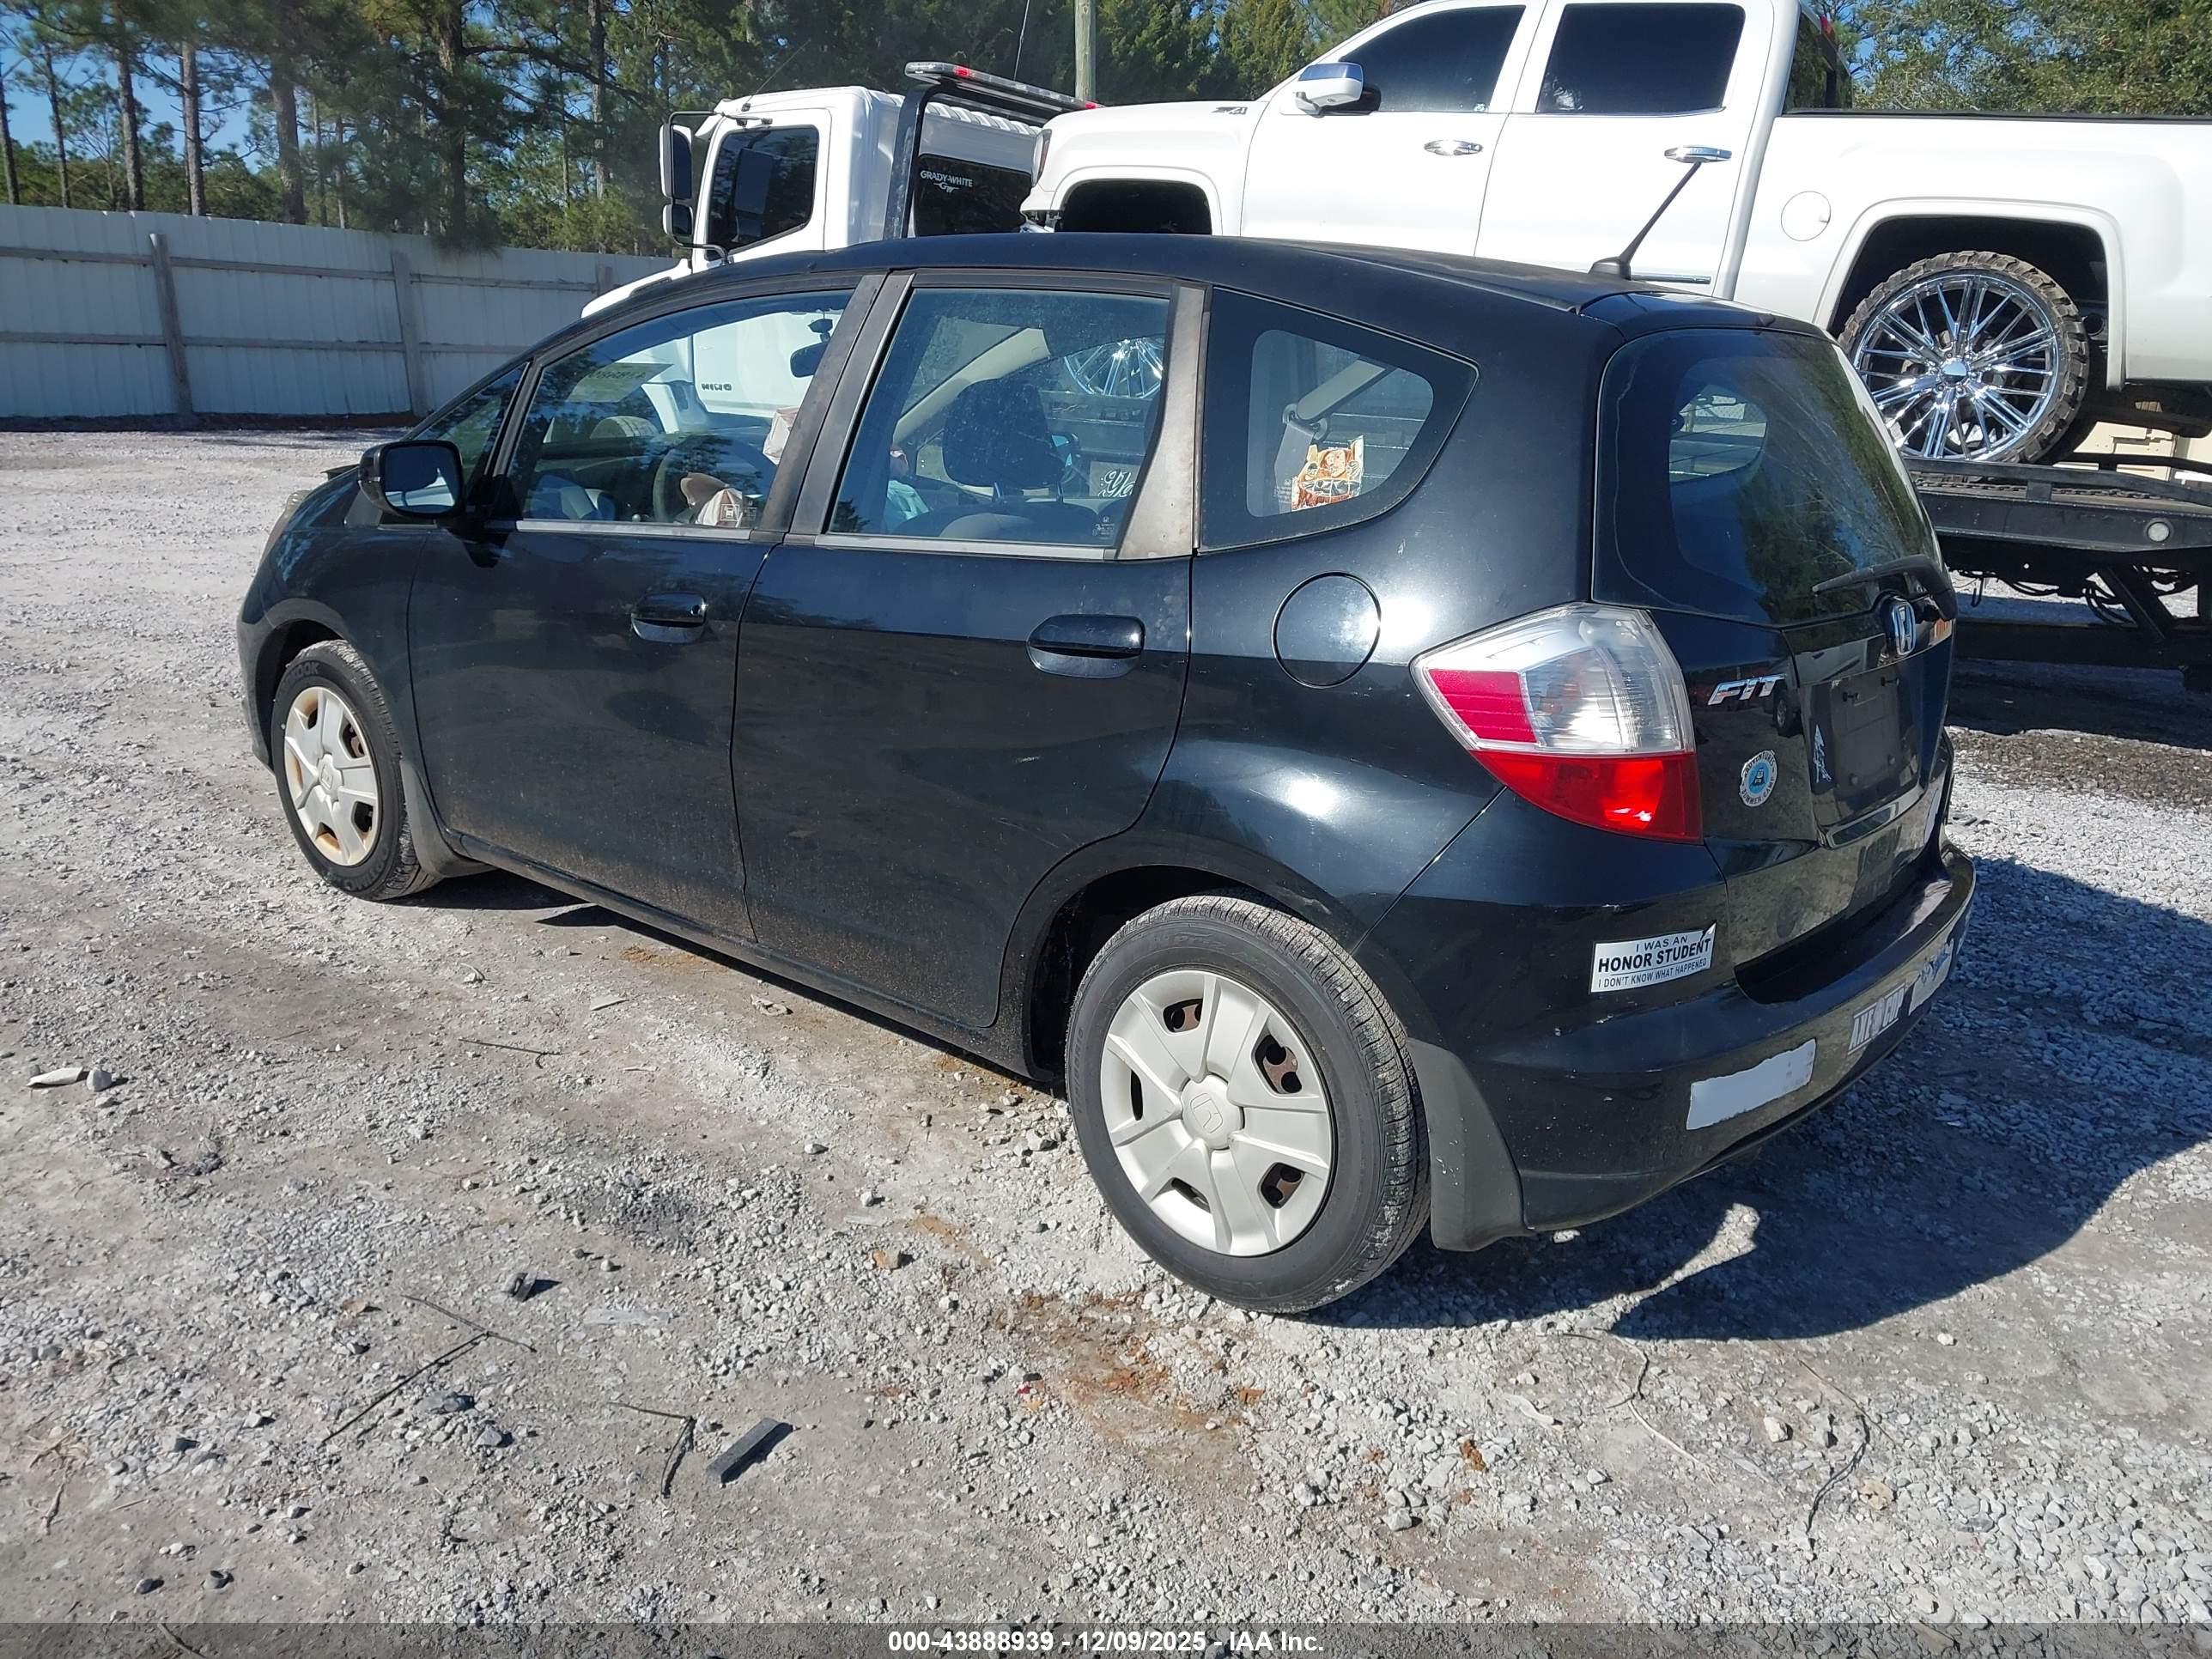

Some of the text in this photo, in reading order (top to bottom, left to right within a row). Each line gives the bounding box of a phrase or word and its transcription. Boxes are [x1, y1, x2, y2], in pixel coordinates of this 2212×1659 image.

[920, 170, 973, 187] GRADY-WHITE
[1707, 673, 1787, 706] FIT
[1598, 938, 1711, 973] HONOR STUDENT
[1636, 935, 1688, 952] I WAS AN
[1603, 976, 1629, 988] DON'T
[1631, 971, 1654, 984] KNOW
[1655, 968, 1674, 981] WHAT
[1675, 957, 1707, 974] HAPPENED
